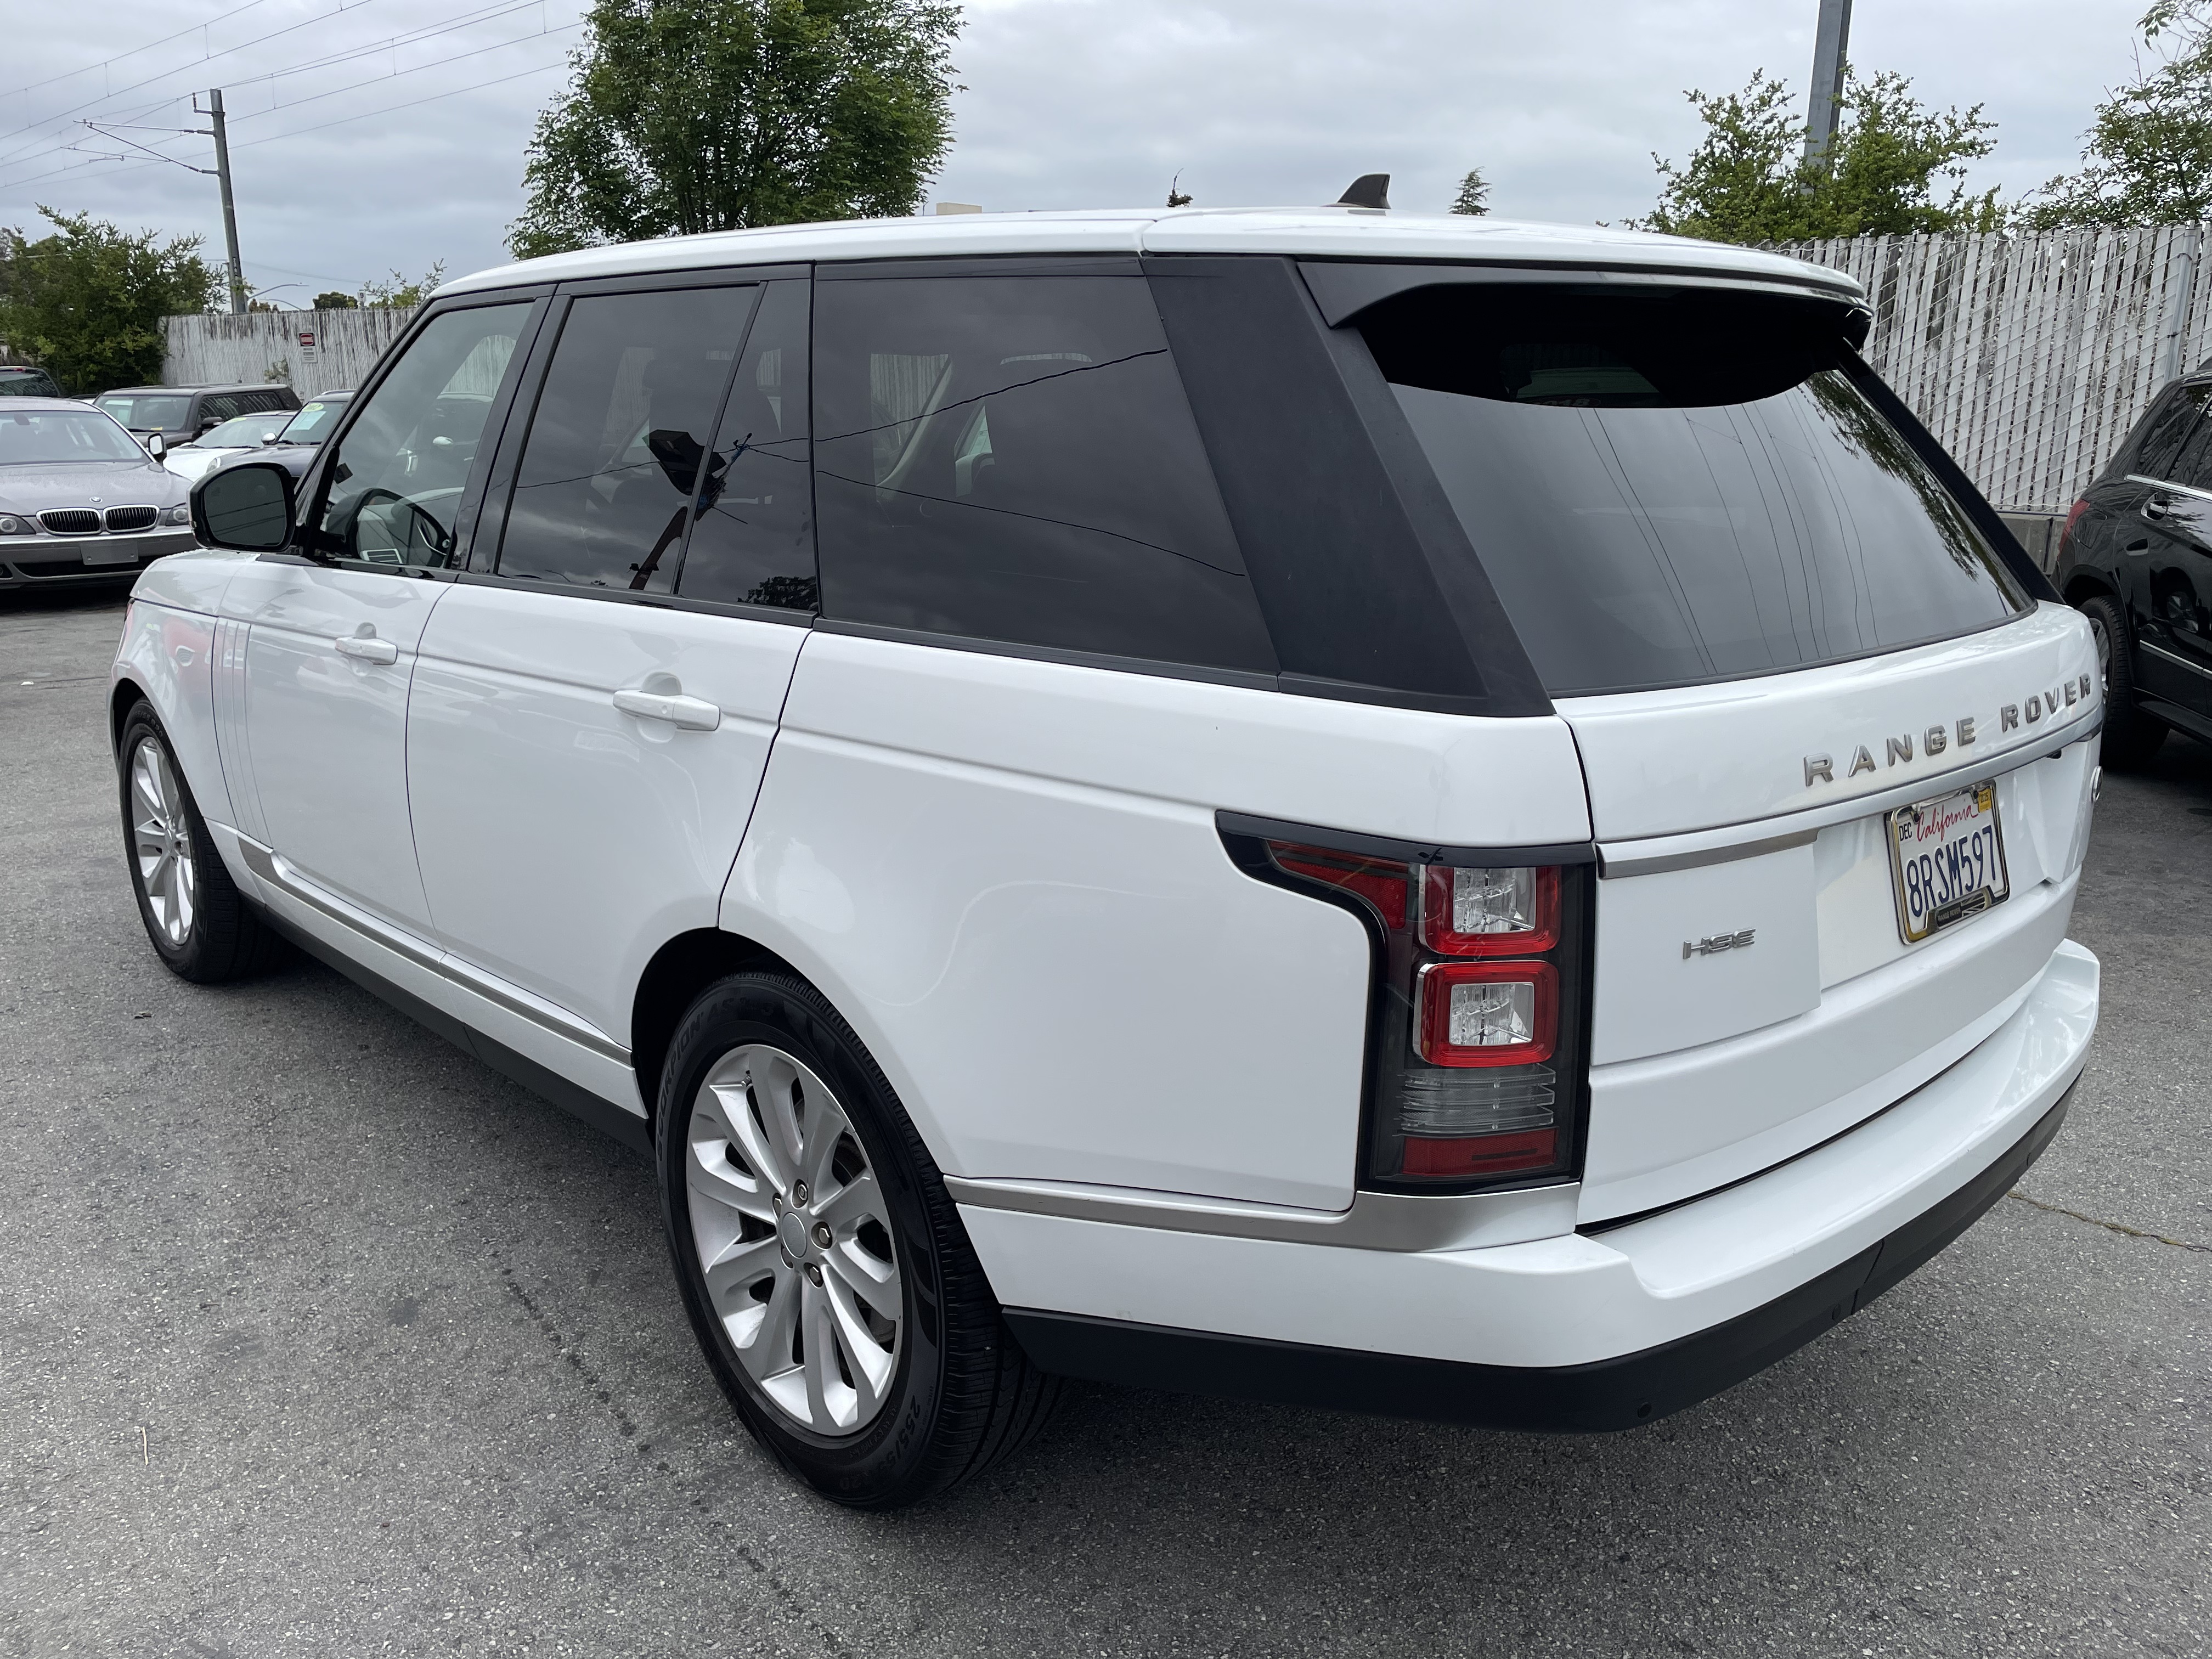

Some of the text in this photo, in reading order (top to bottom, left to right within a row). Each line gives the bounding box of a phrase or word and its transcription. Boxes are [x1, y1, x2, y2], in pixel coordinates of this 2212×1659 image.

[1533, 398, 1590, 407] 018
[1804, 673, 2091, 787] RANGE ROVER
[1899, 823, 1912, 842] DEC
[1916, 804, 1979, 843] California
[1906, 824, 1996, 918] 8RSM597
[1682, 926, 1756, 960] HSE
